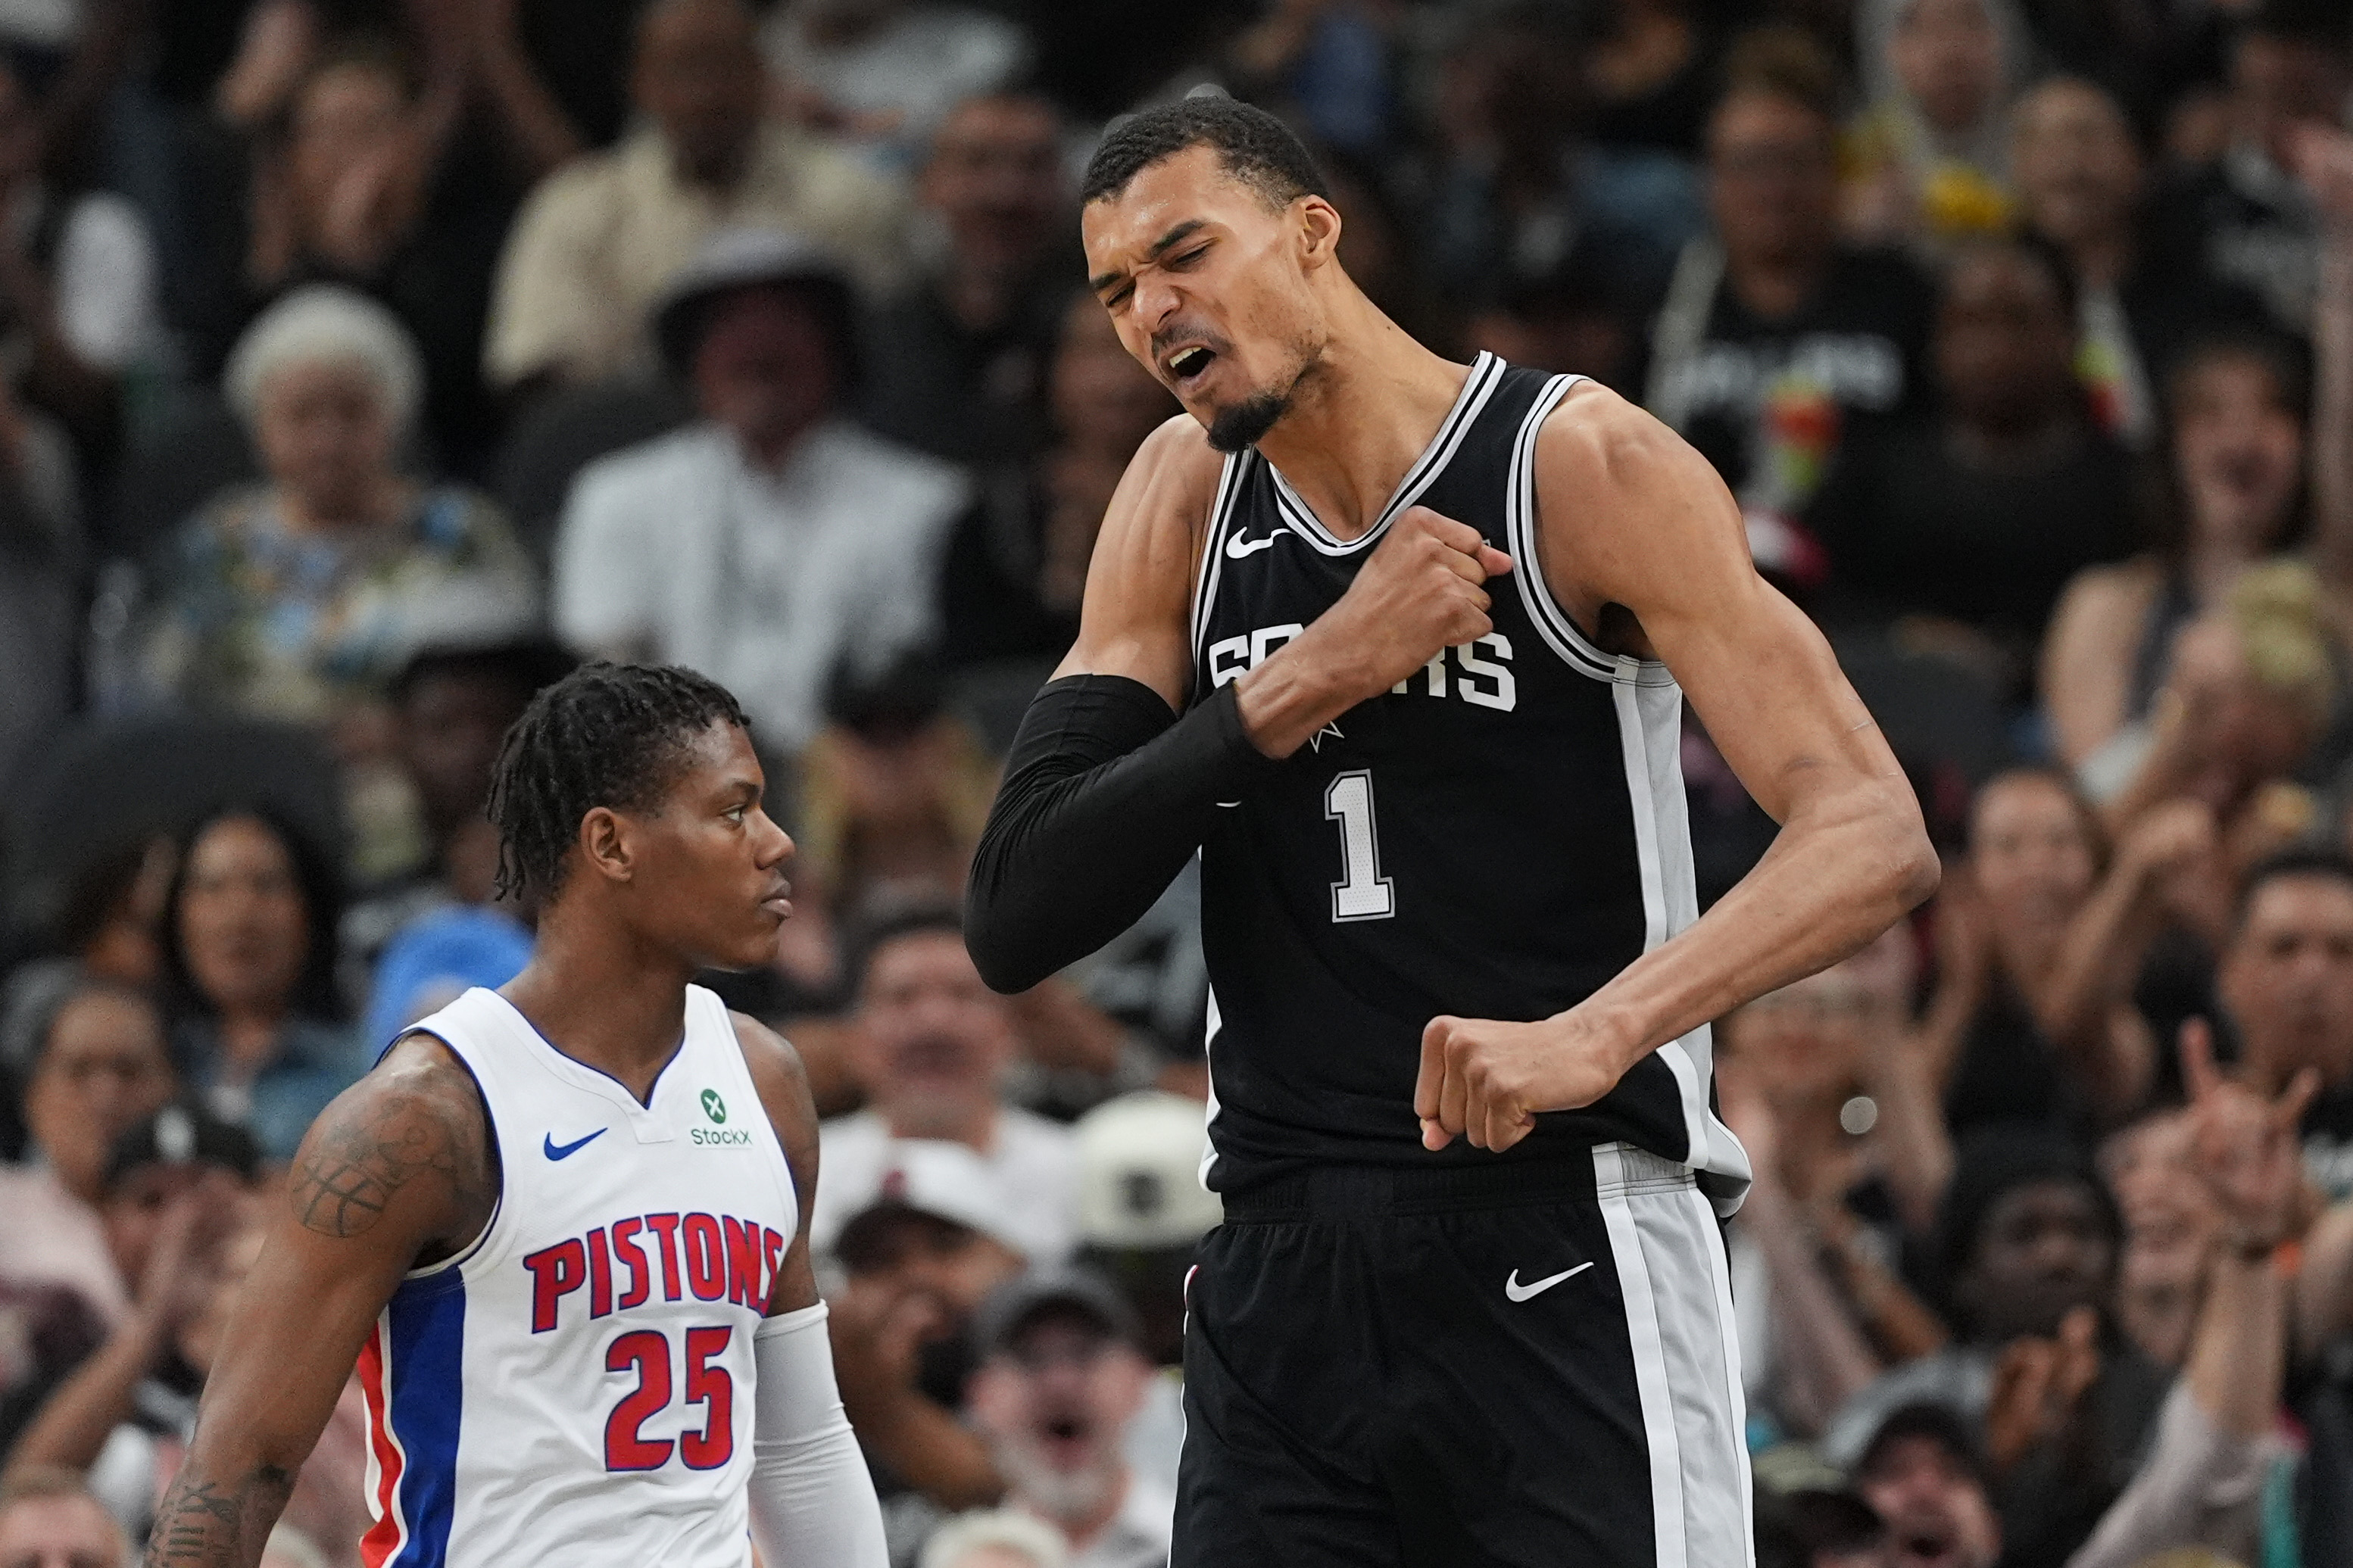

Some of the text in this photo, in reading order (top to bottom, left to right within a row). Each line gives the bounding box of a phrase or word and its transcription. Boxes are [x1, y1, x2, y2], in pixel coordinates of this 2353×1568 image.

[1209, 623, 1516, 712] SPRS
[1325, 768, 1395, 923] 1
[691, 1128, 753, 1146] StockX
[523, 1212, 783, 1334] PISTONS
[604, 1325, 733, 1472] 25
